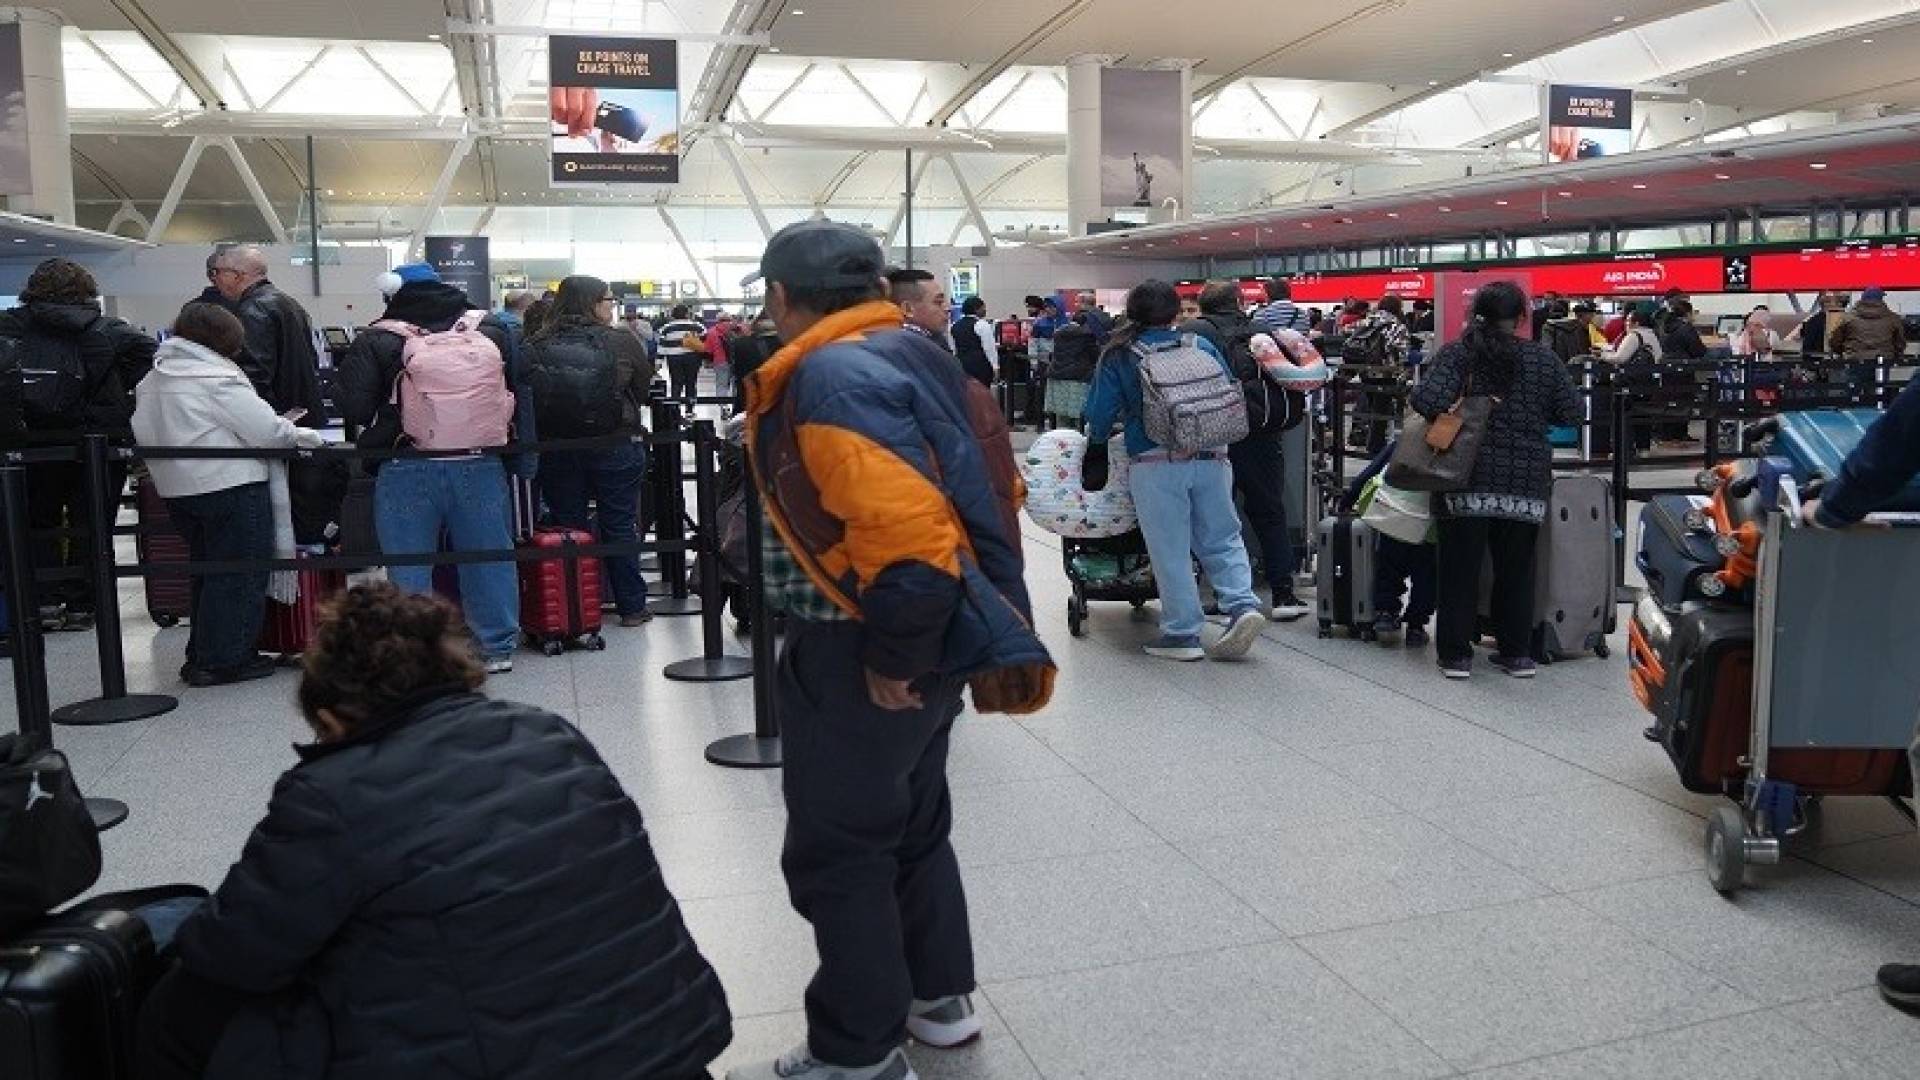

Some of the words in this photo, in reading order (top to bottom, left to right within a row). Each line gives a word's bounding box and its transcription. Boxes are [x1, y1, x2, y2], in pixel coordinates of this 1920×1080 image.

[595, 51, 632, 63] POINTS
[633, 53, 649, 64] ON
[577, 62, 610, 74] CHASE
[613, 63, 651, 76] TRAVEL
[1602, 271, 1625, 283] AIR
[1626, 270, 1660, 282] INDIA
